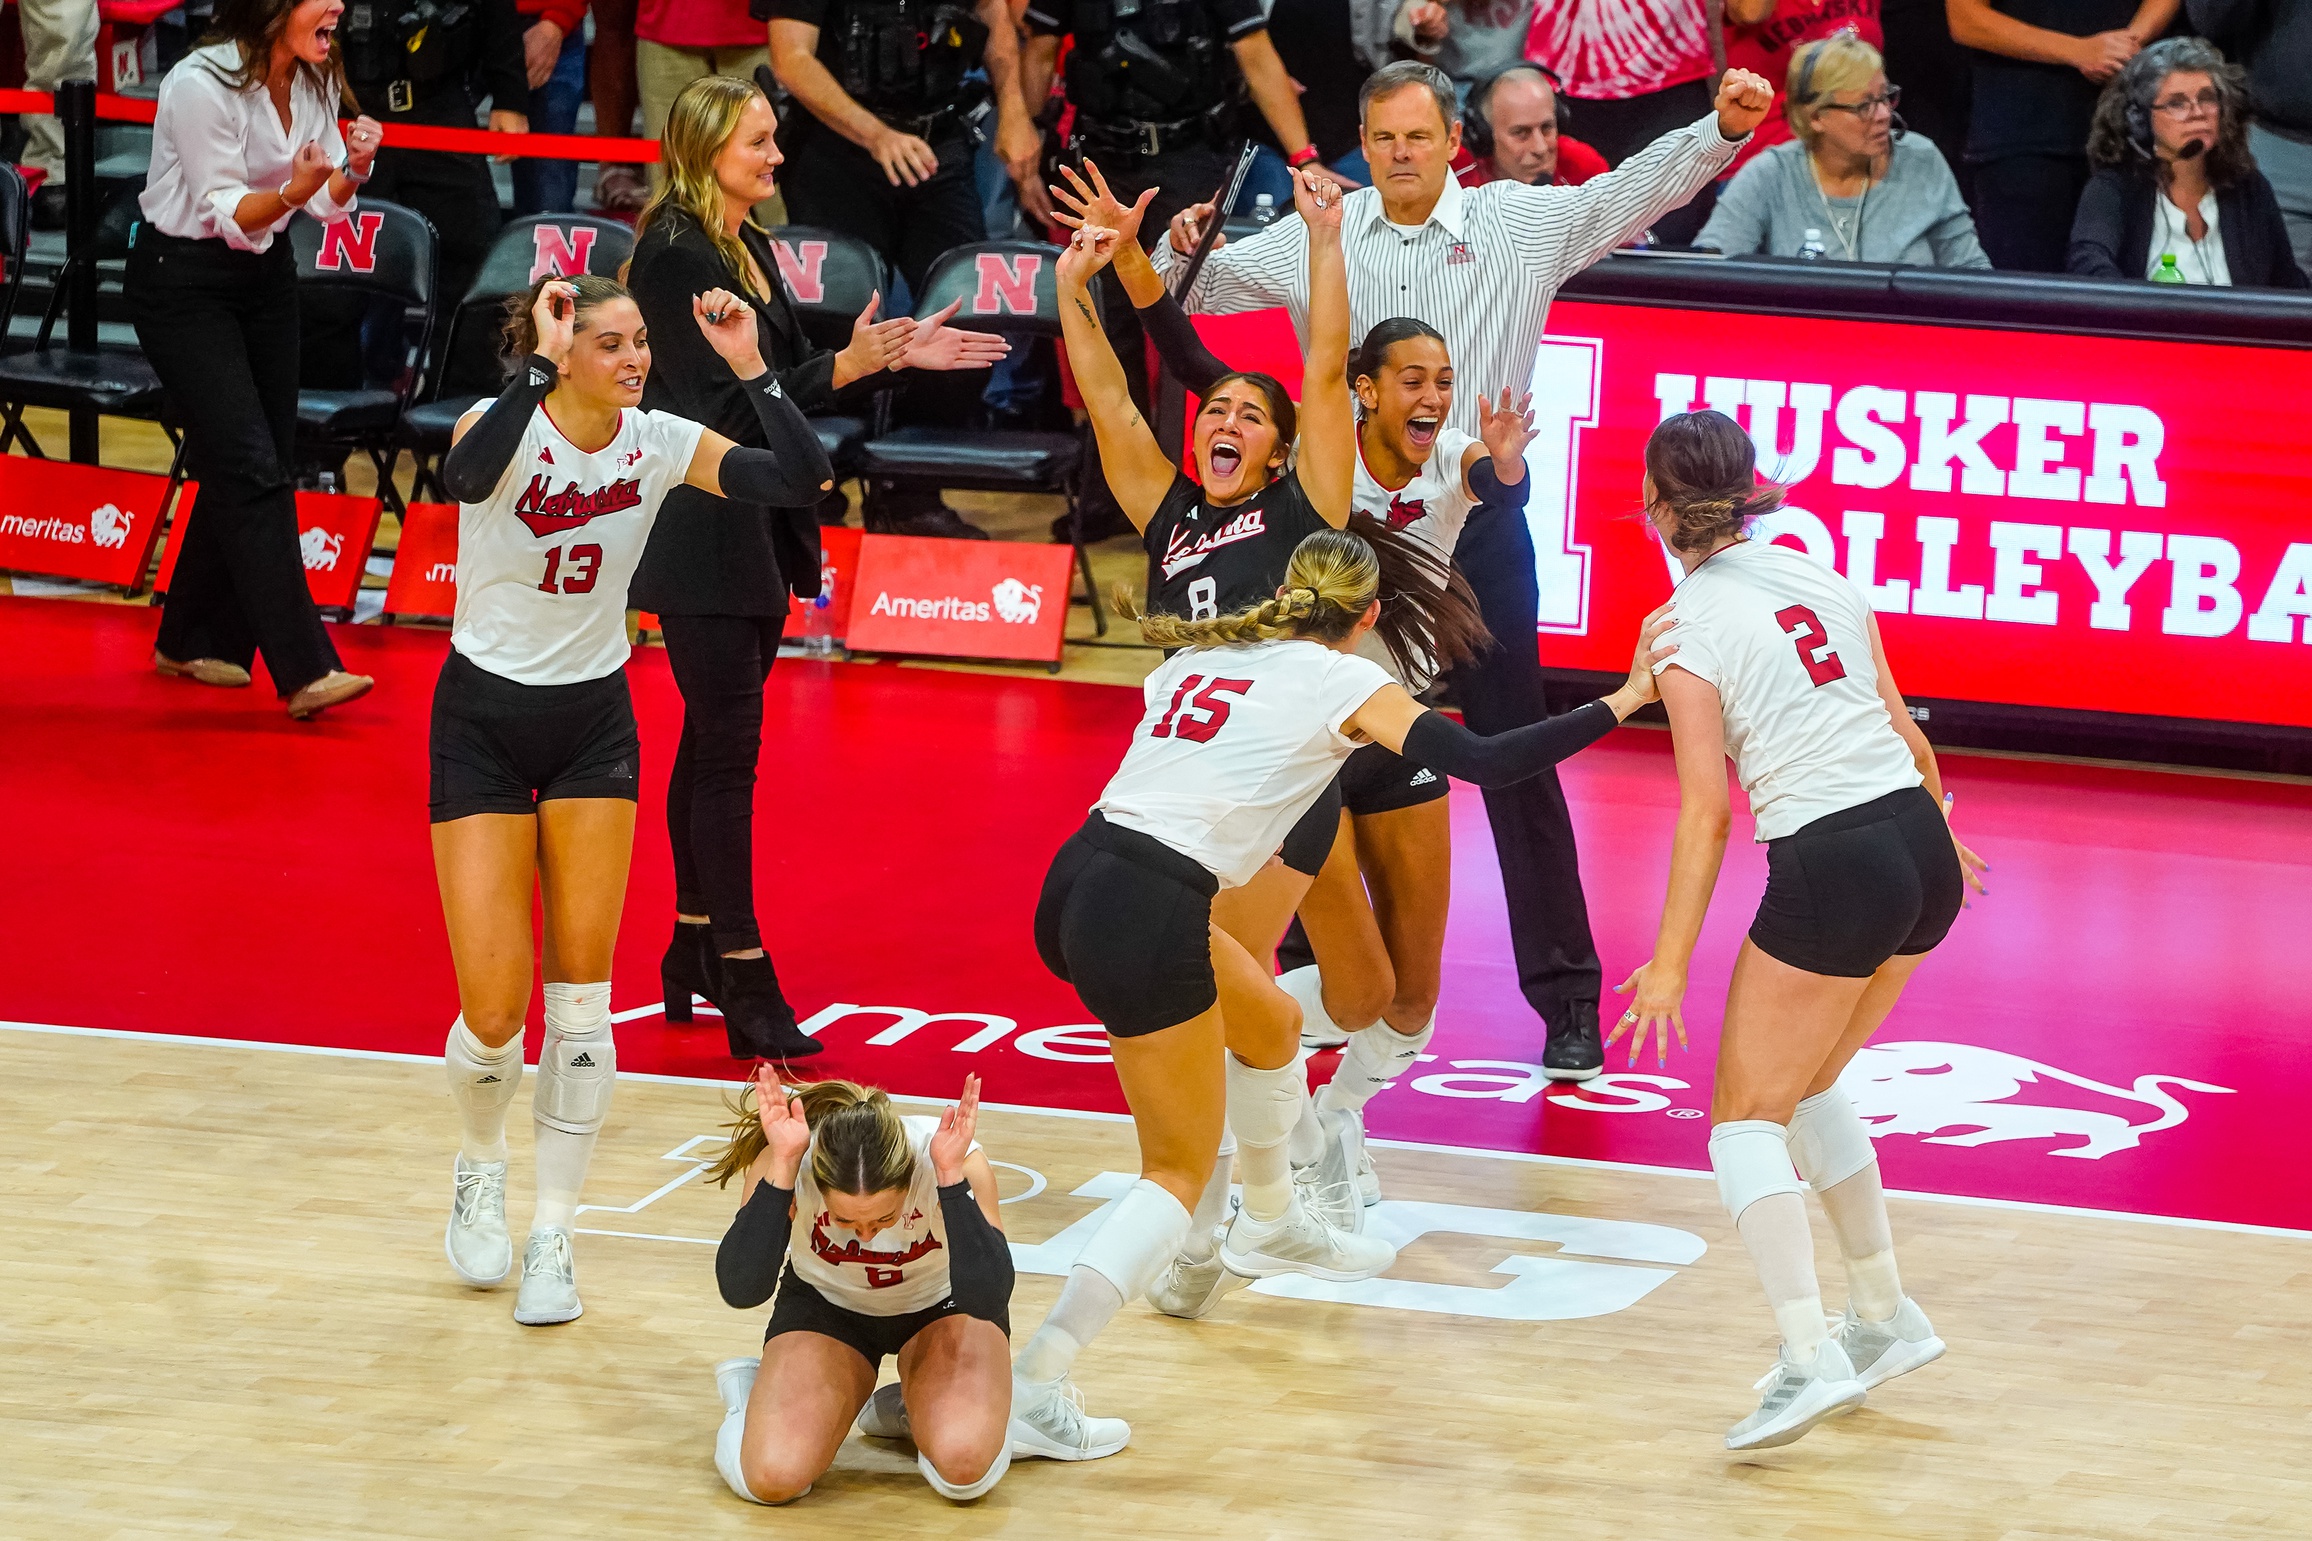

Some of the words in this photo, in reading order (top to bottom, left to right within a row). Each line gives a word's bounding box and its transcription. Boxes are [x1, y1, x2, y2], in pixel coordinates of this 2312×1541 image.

[316, 210, 384, 272] N
[529, 224, 597, 285] N
[769, 241, 828, 303] N
[973, 253, 1042, 315] N
[515, 474, 642, 530] Nebraska
[538, 543, 603, 594] 13
[870, 591, 990, 622] Ameritas
[1188, 576, 1217, 622] 8
[1774, 603, 1847, 688] 2
[1151, 673, 1255, 744] 15
[1410, 774, 1437, 787] adidas
[865, 1266, 904, 1288] 6
